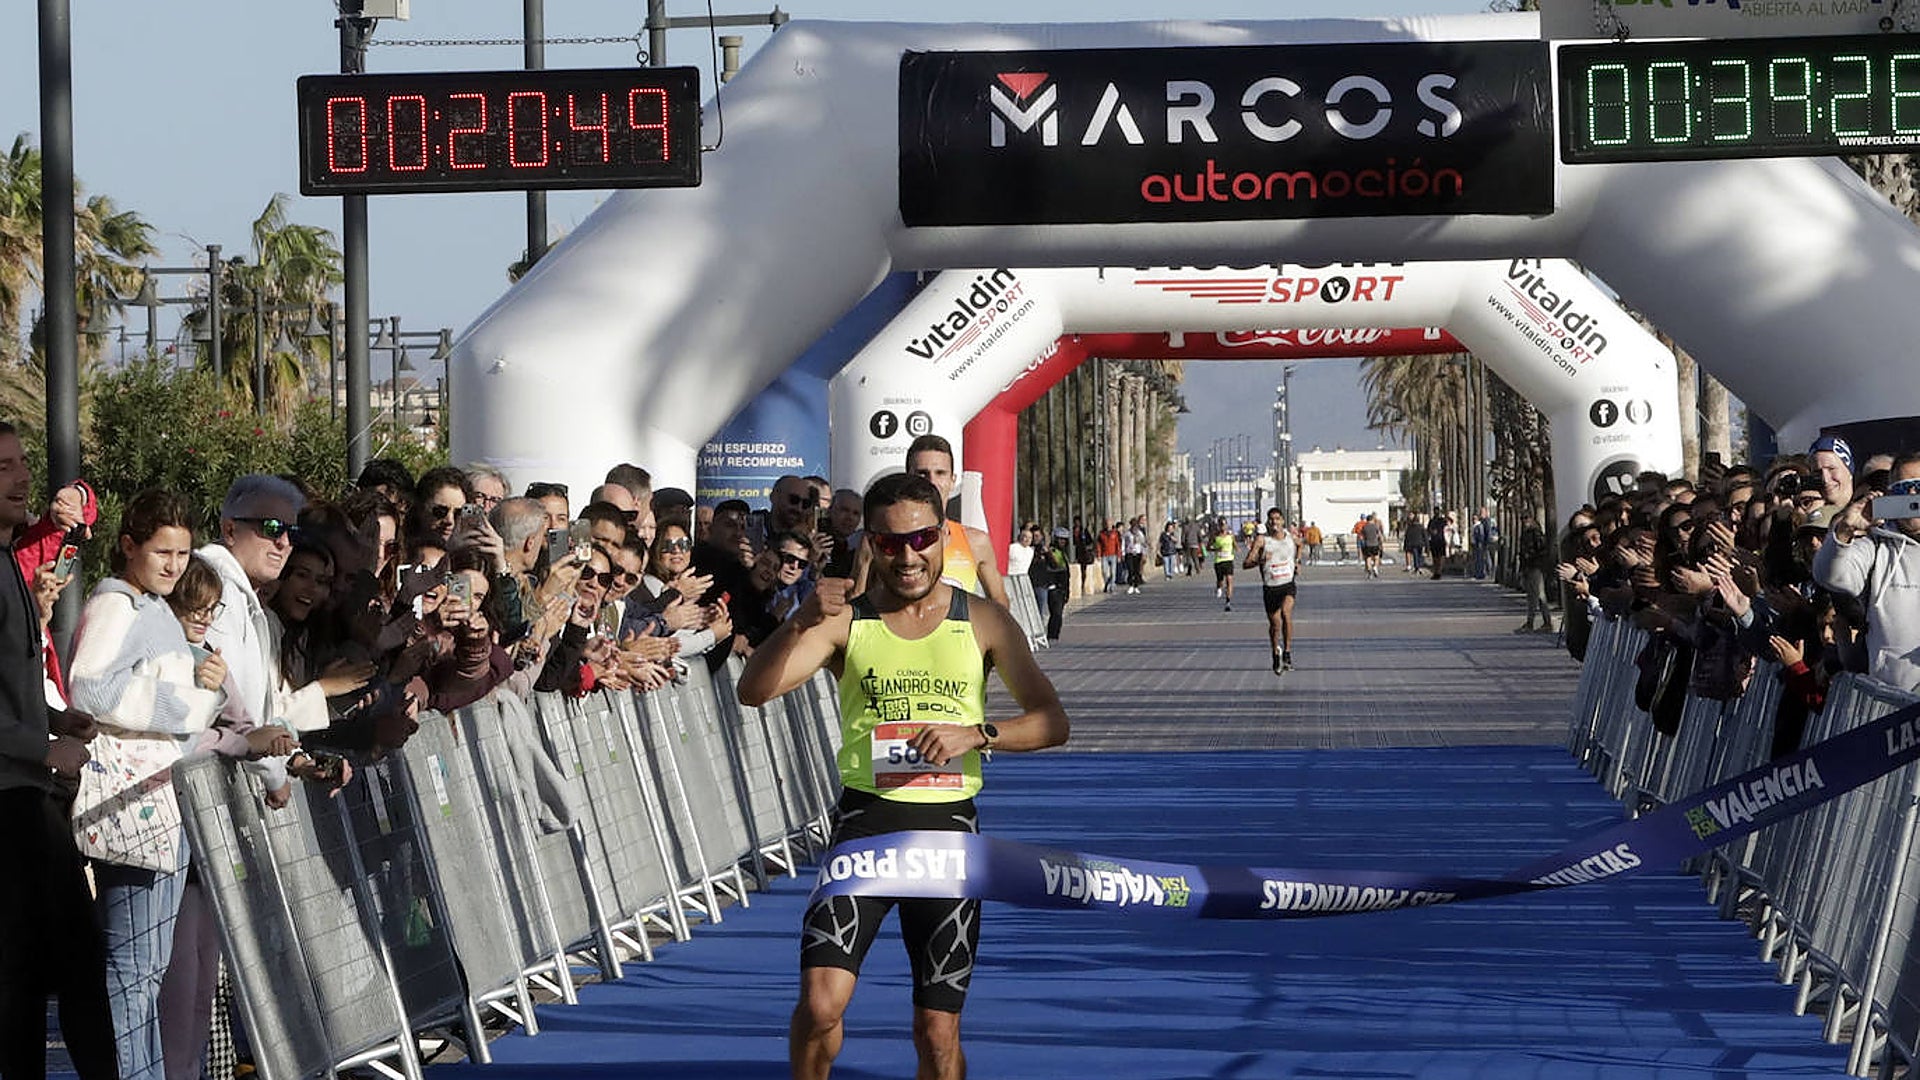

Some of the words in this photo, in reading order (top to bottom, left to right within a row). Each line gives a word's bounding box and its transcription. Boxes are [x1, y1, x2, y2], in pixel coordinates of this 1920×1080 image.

[1740, 2, 1801, 16] ABIERTA
[1807, 3, 1827, 15] AL
[1832, 2, 1870, 14] MAR
[989, 72, 1463, 147] MARCOS
[327, 88, 671, 173] 00:20:49
[1141, 156, 1464, 203] automoción
[979, 281, 1024, 331] SPORT
[1268, 275, 1404, 303] SPORT
[948, 299, 1036, 381] www.vitaldin.com
[1488, 294, 1578, 378] www.vitaldin.com
[1542, 320, 1594, 365] SPORT
[704, 457, 725, 467] HAY
[727, 457, 805, 467] RECOMPENSA
[705, 443, 723, 454] SIN
[725, 443, 787, 454] ESFUERZO
[739, 488, 760, 497] con
[934, 678, 968, 698] SANZ
[916, 702, 962, 716] SOUL
[888, 745, 937, 765] 50
[1706, 758, 1825, 829] VALENCIA
[904, 848, 967, 881] LAS
[1039, 858, 1164, 907] VALENCIA
